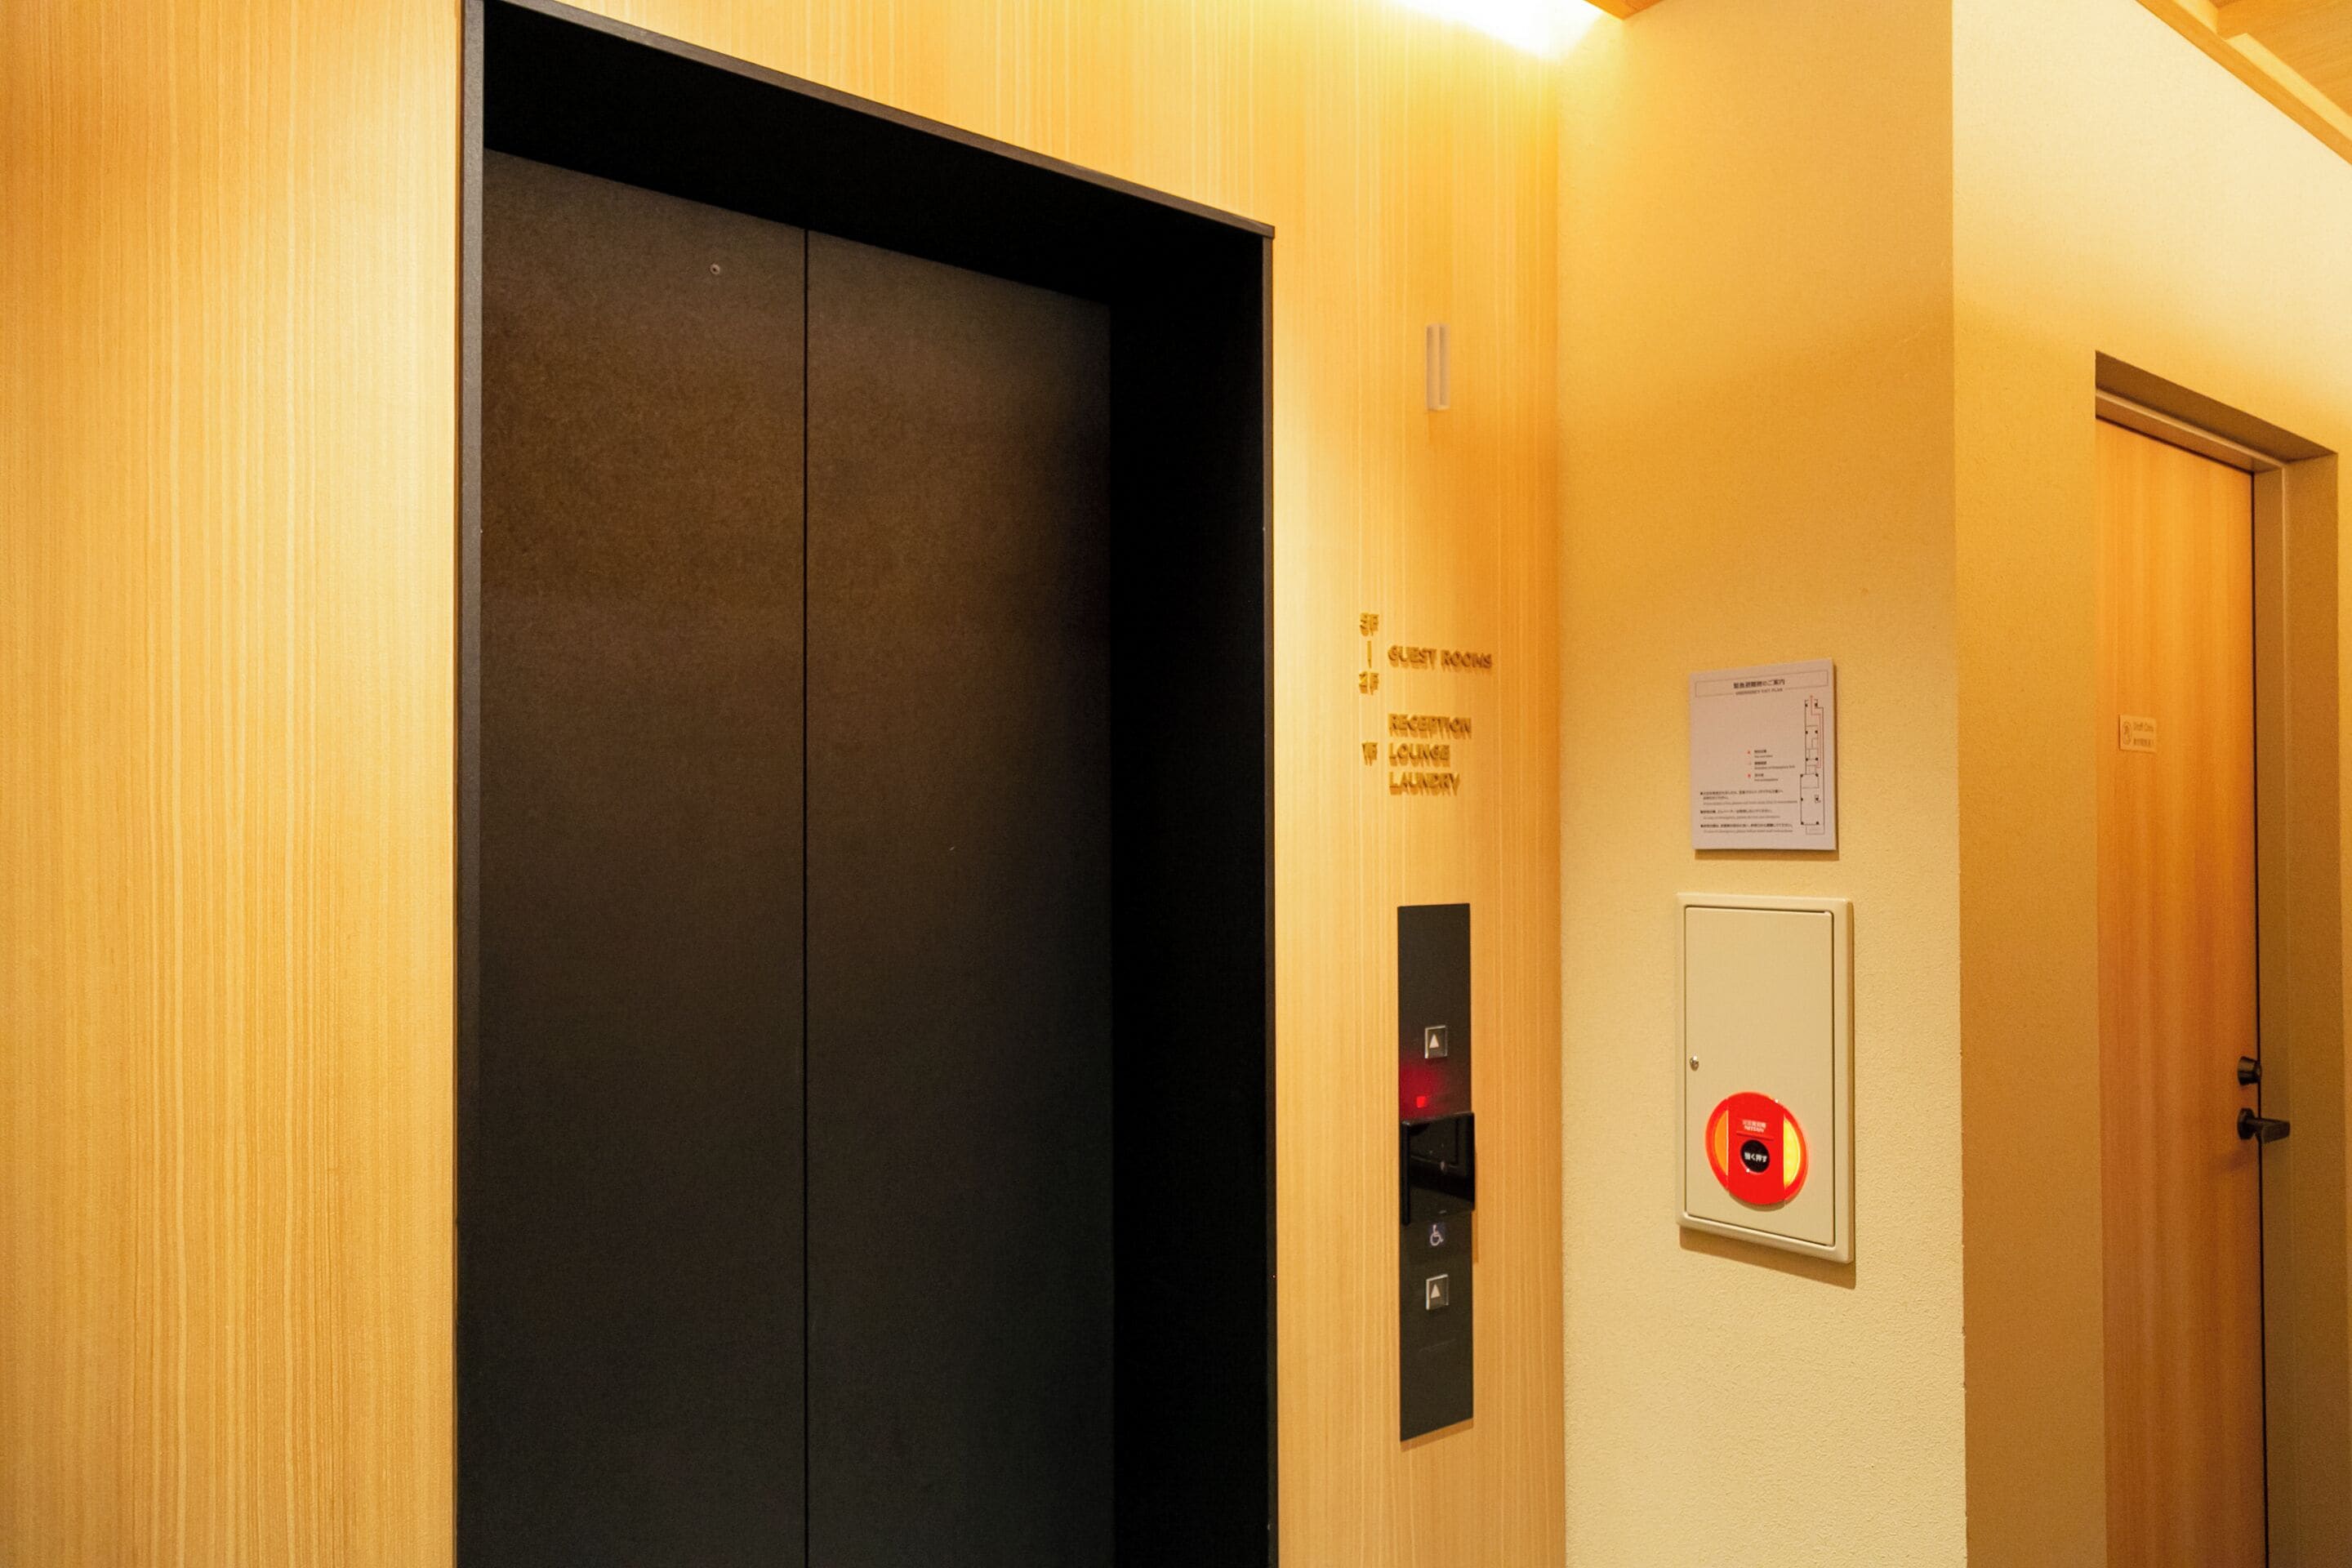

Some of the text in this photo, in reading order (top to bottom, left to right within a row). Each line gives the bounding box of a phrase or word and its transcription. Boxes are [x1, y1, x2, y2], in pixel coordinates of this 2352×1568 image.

[1360, 612, 1379, 635] 3F
[1388, 645, 1493, 670] GUEST ROOMS
[1359, 671, 1379, 694] 2F
[1388, 715, 1472, 737] RECEPTION
[1388, 742, 1450, 765] LOUNGE
[1389, 772, 1460, 795] LAUNDRY
